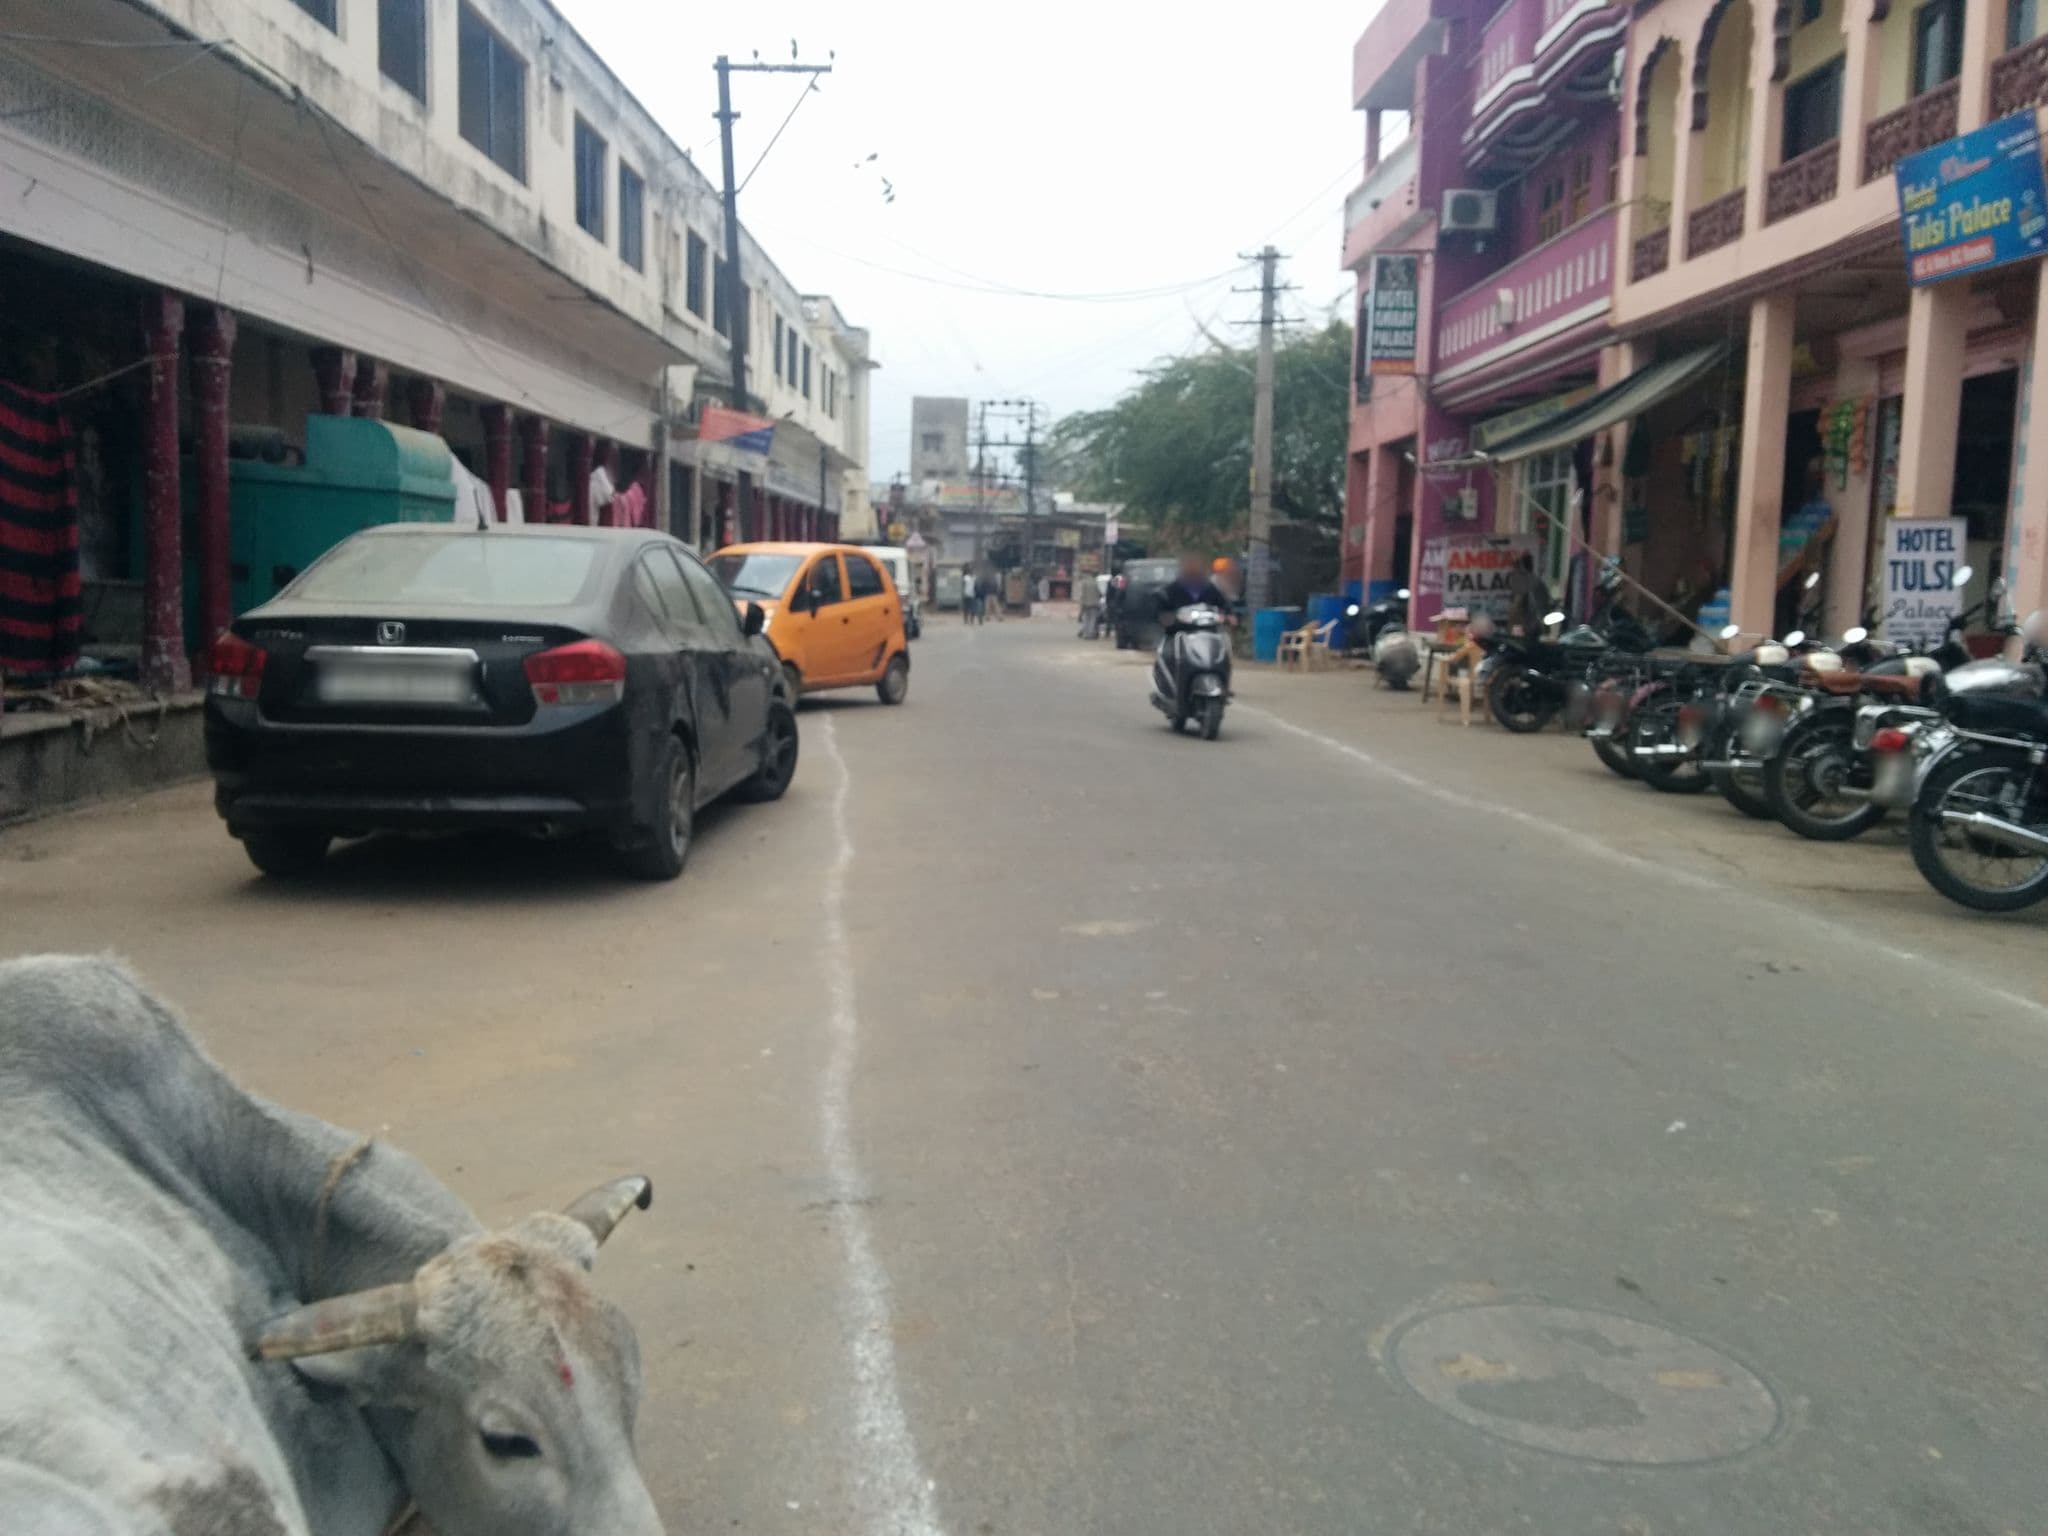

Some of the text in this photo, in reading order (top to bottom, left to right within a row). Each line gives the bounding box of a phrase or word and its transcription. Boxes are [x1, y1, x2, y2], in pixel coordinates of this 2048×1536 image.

[1906, 209, 1945, 250] Tulsi
[1948, 196, 2012, 239] Palace
[1897, 528, 1955, 553] HOTEL
[1889, 559, 1954, 592] TULSI
